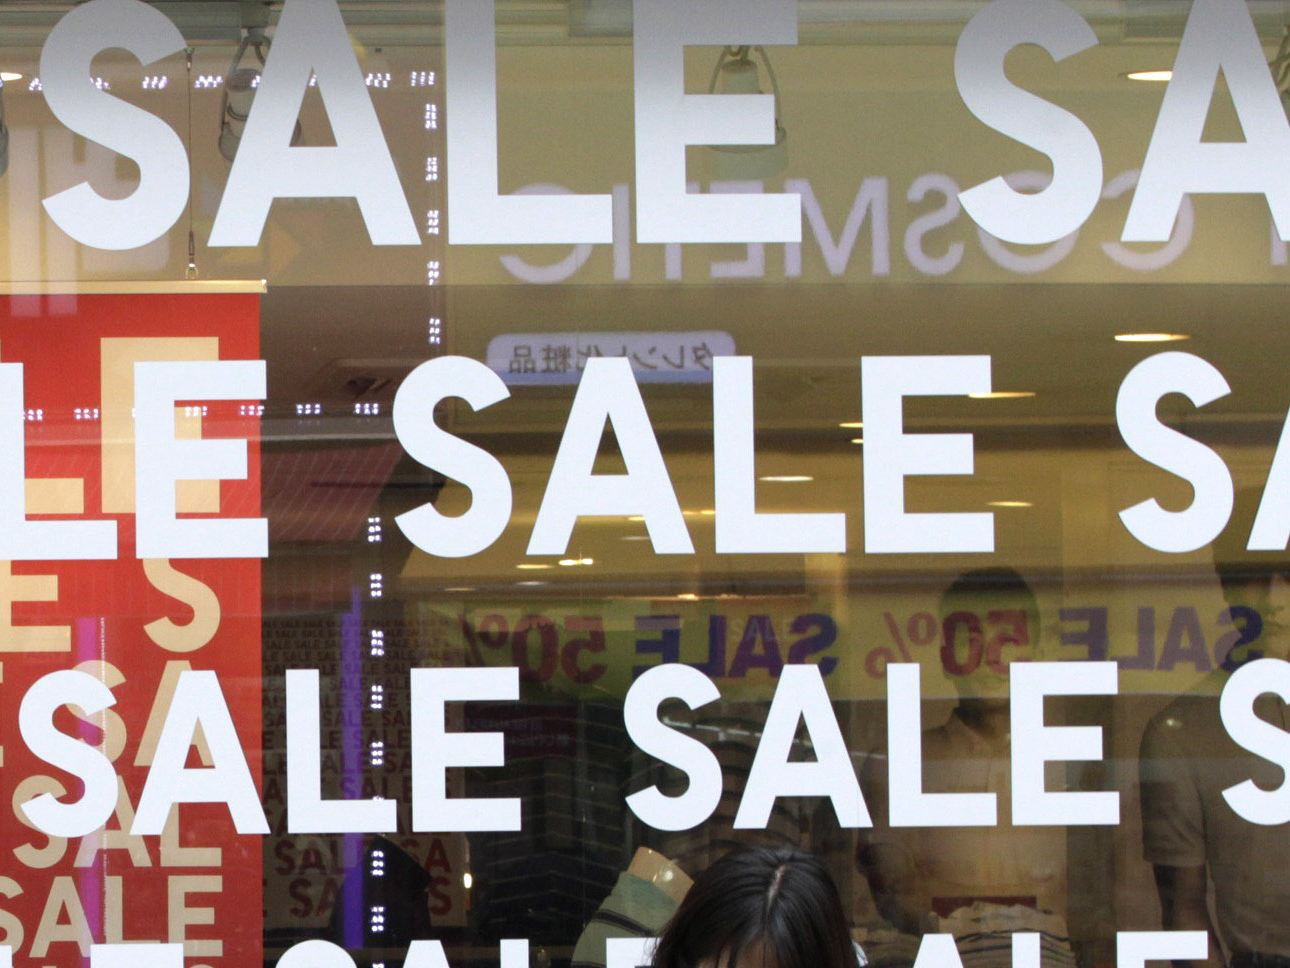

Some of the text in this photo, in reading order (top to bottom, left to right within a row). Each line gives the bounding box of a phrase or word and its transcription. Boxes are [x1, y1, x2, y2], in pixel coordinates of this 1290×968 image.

[41, 0, 801, 251] SALE
[393, 356, 994, 557] SALE
[20, 668, 521, 837] SALE
[624, 662, 1119, 830] SALE
